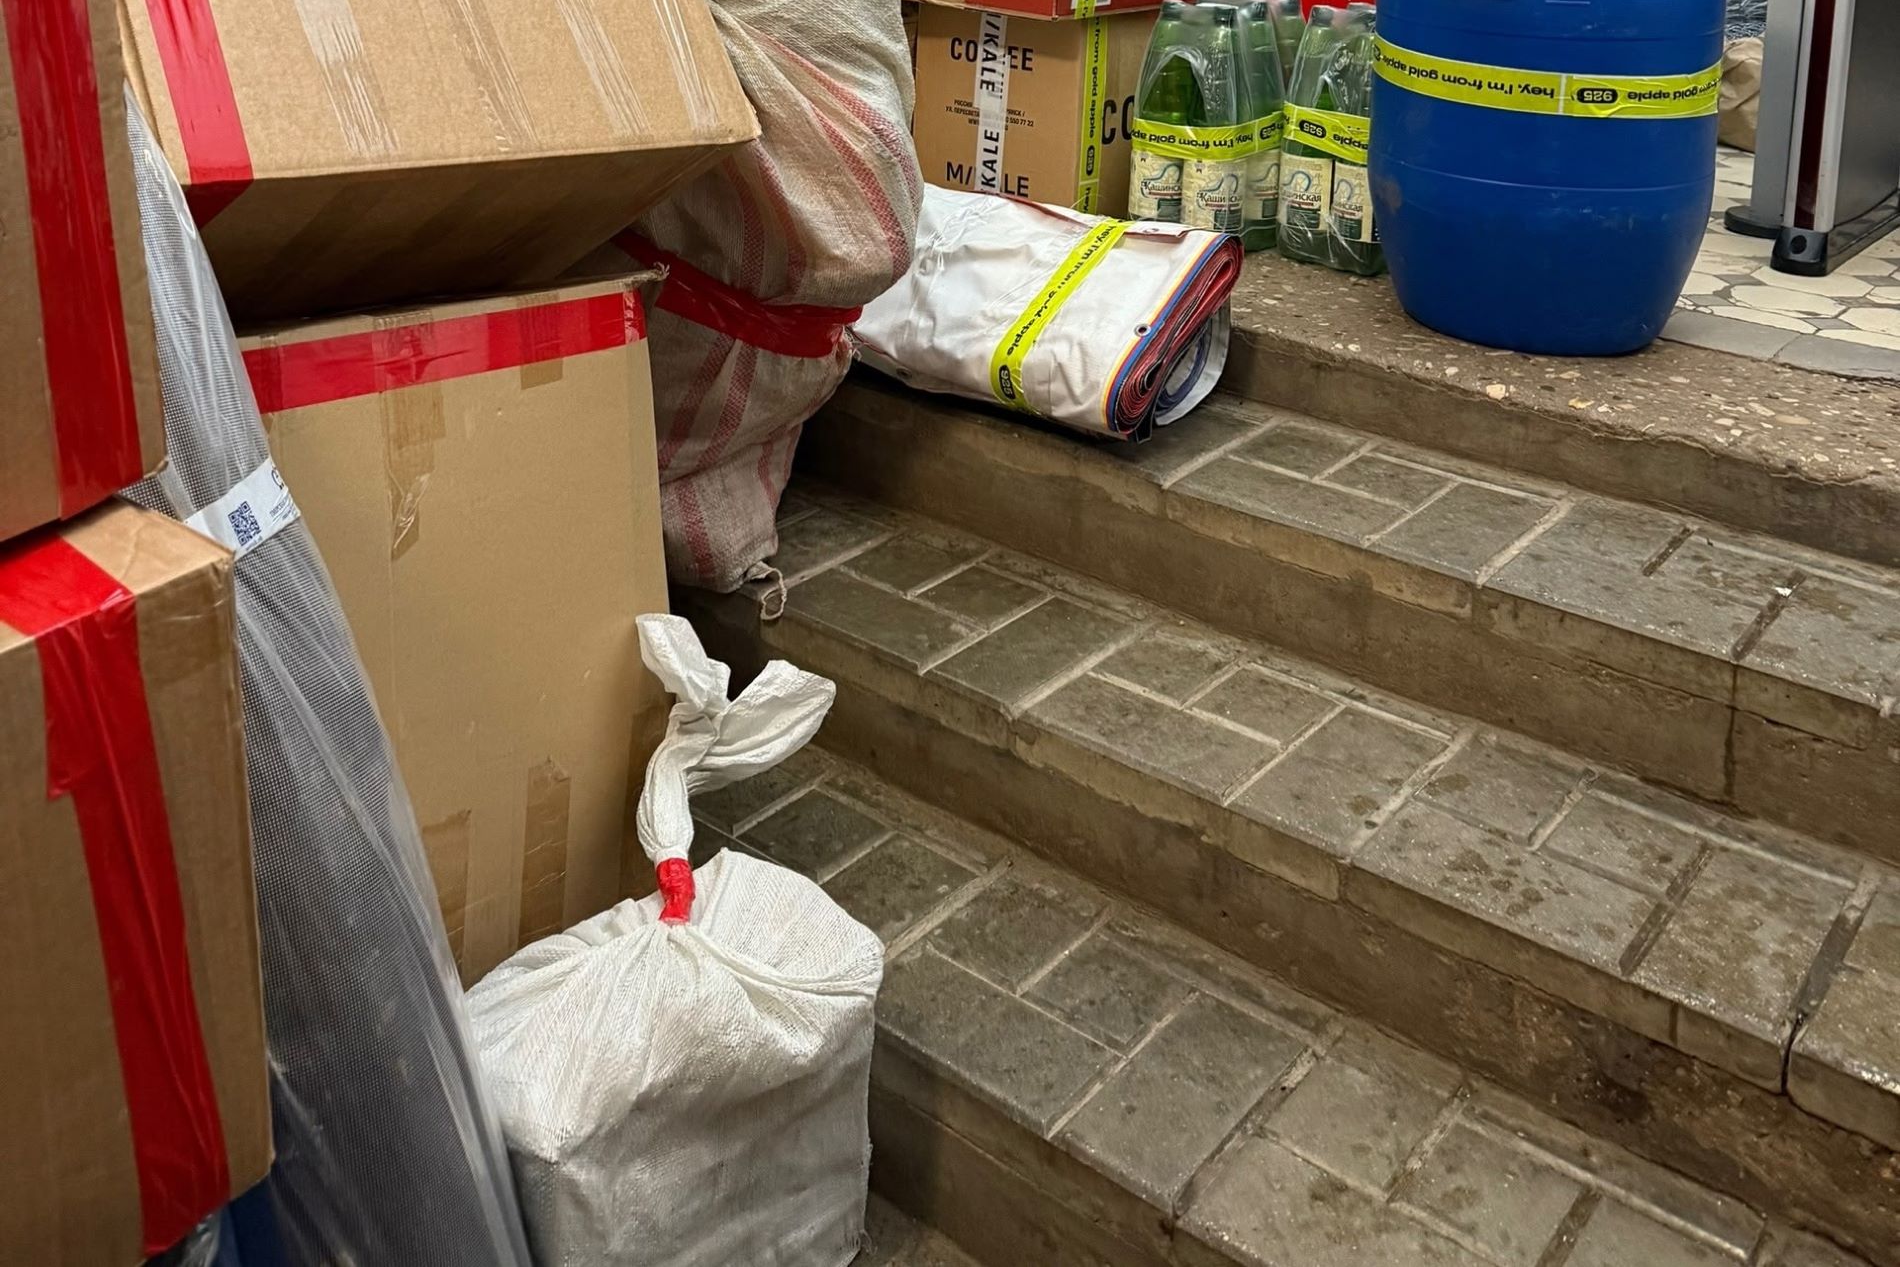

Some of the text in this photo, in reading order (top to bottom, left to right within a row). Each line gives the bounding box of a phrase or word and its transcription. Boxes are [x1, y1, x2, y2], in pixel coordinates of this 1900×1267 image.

[950, 37, 1034, 72] COEE
[1090, 66, 1099, 96] gold
[1407, 65, 1440, 81] gold
[1441, 72, 1484, 90] from
[1487, 80, 1514, 95] I'm
[1518, 84, 1555, 99] hey,
[1581, 88, 1616, 103] 925
[1627, 88, 1672, 102] apple
[1673, 85, 1699, 102] gold
[1088, 100, 1097, 139] apple
[1149, 133, 1176, 146] gold
[1178, 137, 1211, 150] from
[945, 161, 1030, 198] M/LE
